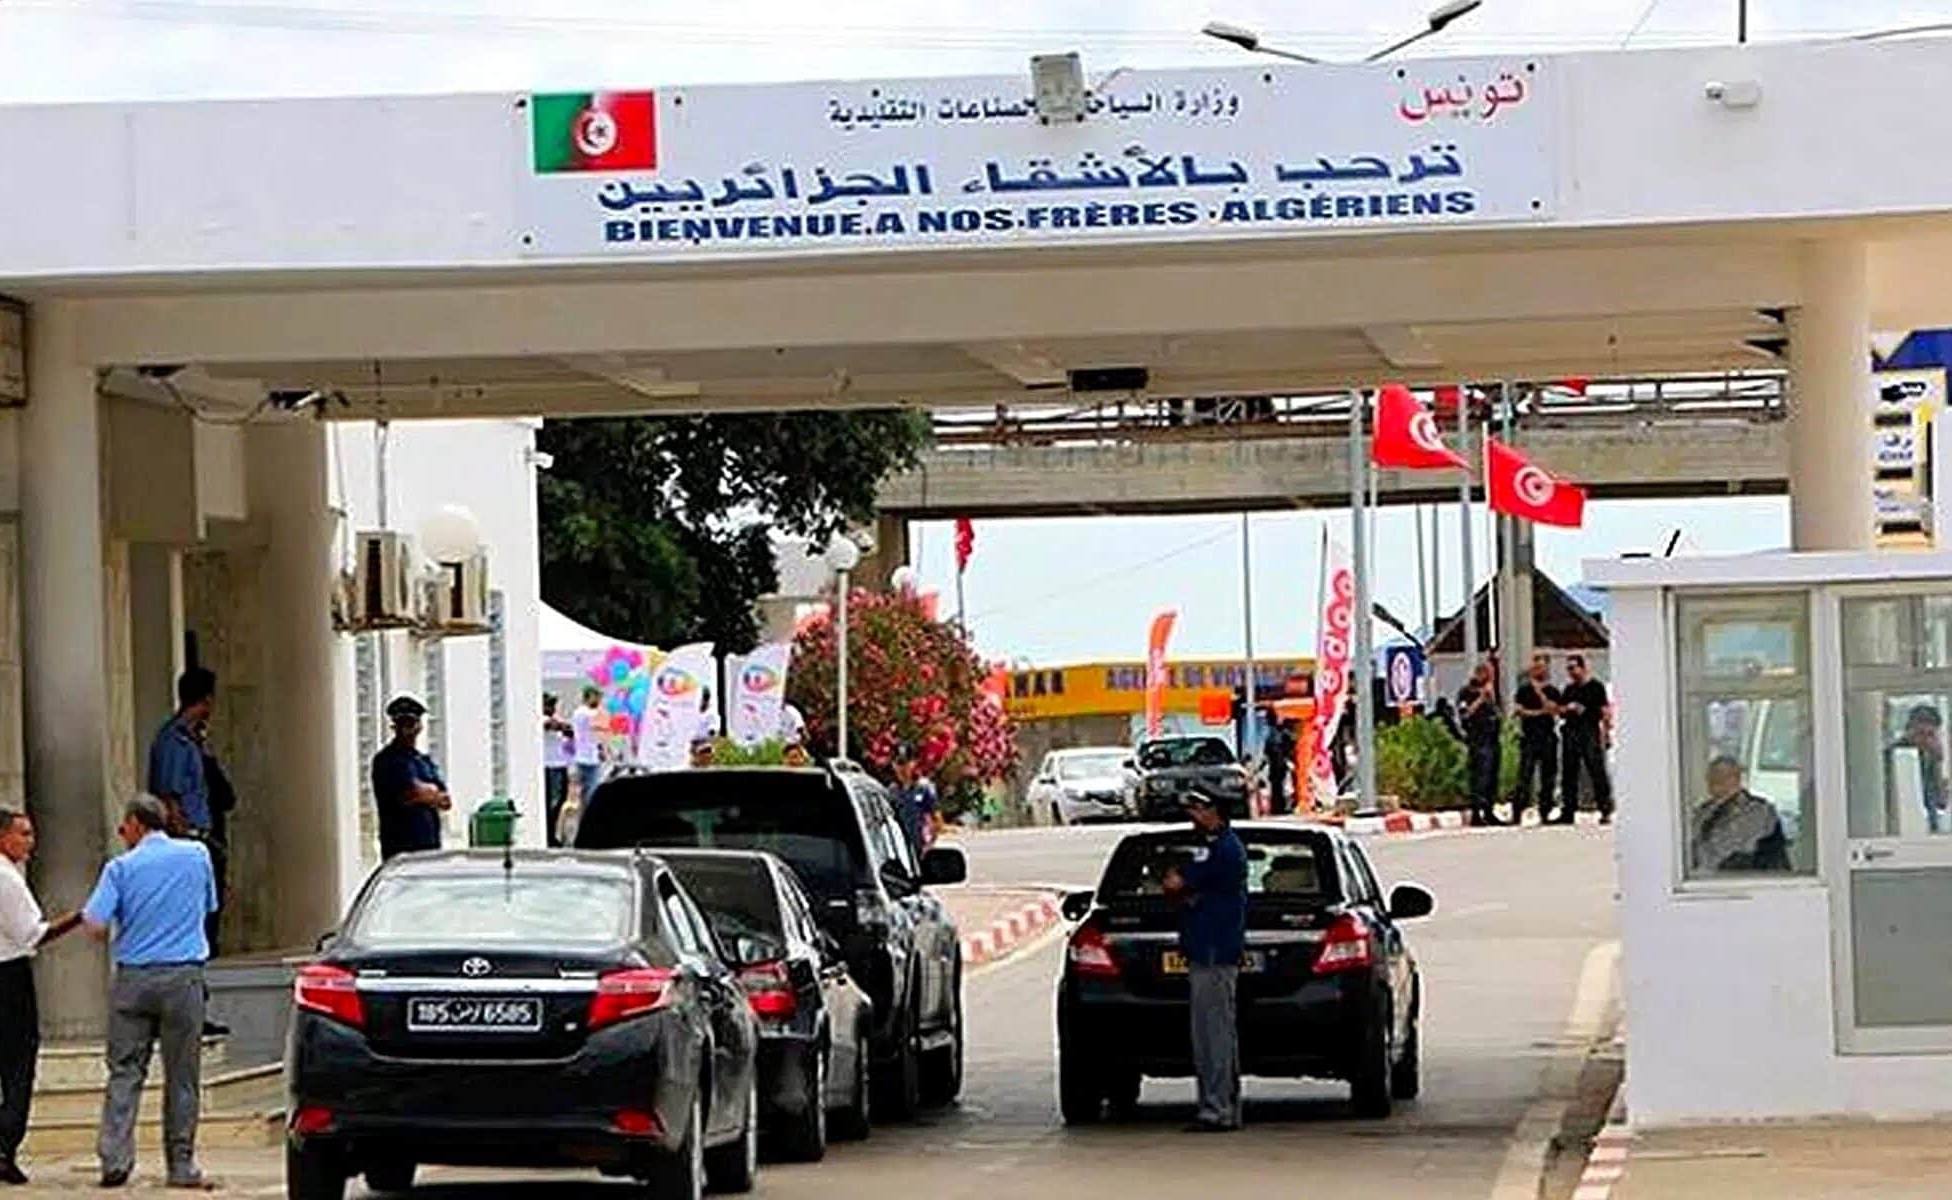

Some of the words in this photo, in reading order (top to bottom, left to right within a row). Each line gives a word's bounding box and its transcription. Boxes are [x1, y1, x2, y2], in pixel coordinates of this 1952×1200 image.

[828, 99, 927, 131] التقليدية
[1085, 92, 1163, 121] السياح
[1174, 87, 1240, 117] وزارة
[1398, 73, 1524, 121] تونس
[597, 162, 933, 212] الجزائريين
[962, 145, 1250, 194] بالأشقاء
[1274, 144, 1463, 190] ترحب
[603, 217, 865, 243] BIENVENUE
[875, 214, 906, 235] A
[917, 208, 1014, 232] NOS
[1027, 199, 1199, 229] FRÈRES
[1218, 190, 1476, 223] ALGÉRIENS
